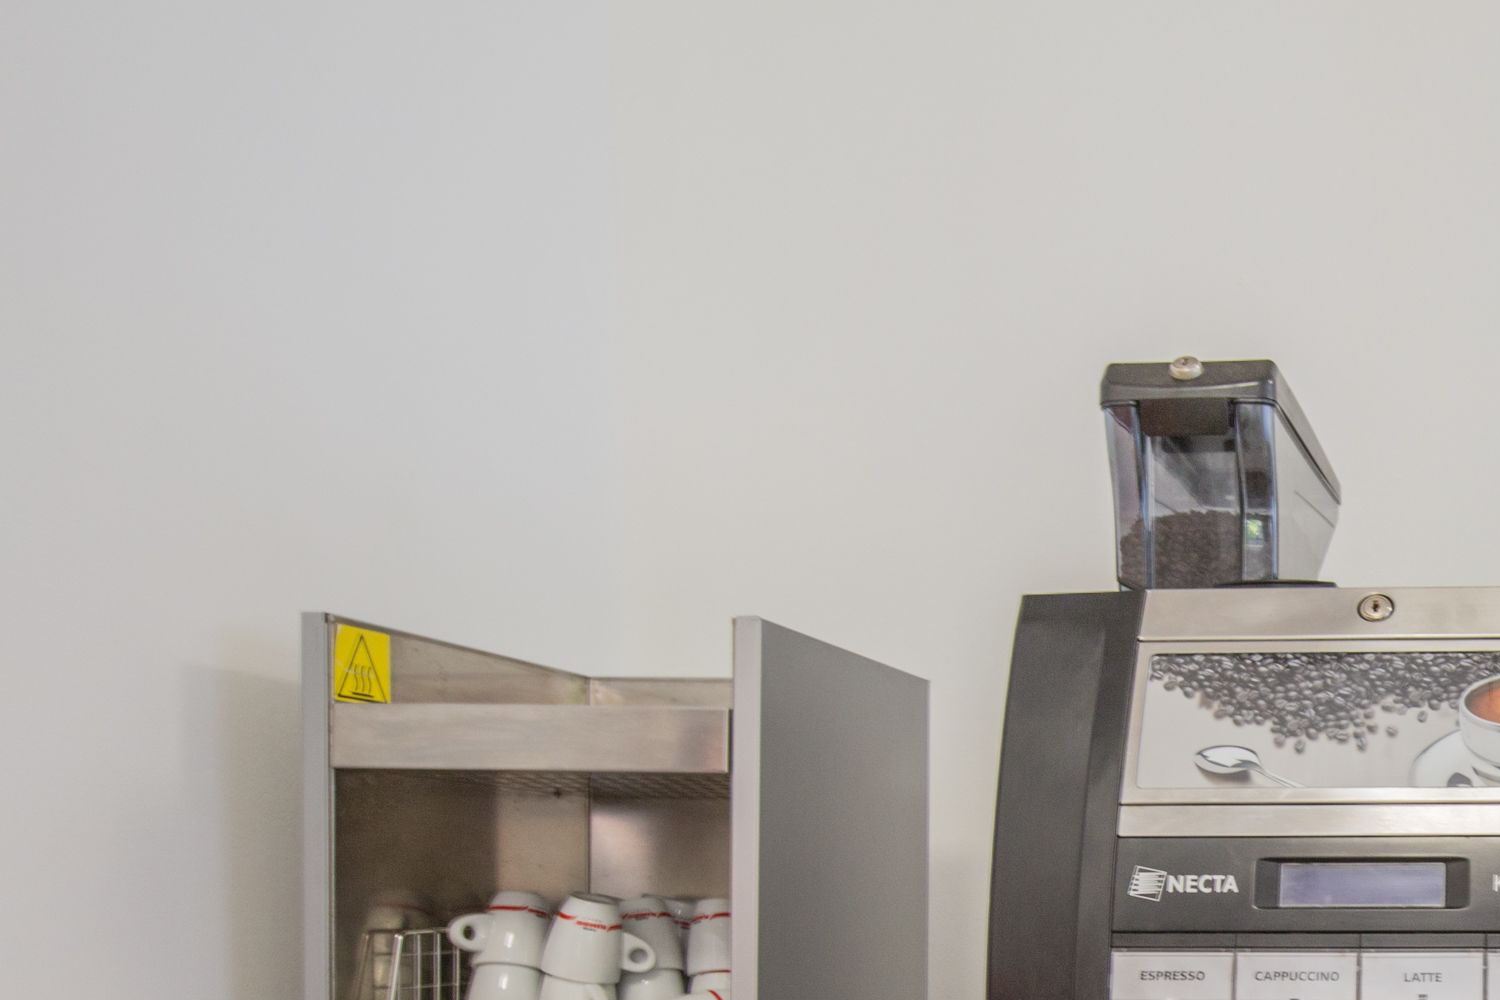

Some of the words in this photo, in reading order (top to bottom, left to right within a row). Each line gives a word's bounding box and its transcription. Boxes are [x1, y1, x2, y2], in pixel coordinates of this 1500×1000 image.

[1166, 874, 1239, 893] NECTA
[1140, 970, 1206, 981] ESPRESSO
[1255, 970, 1340, 982] CAPPUCCINO
[1403, 972, 1443, 983] LATTE
